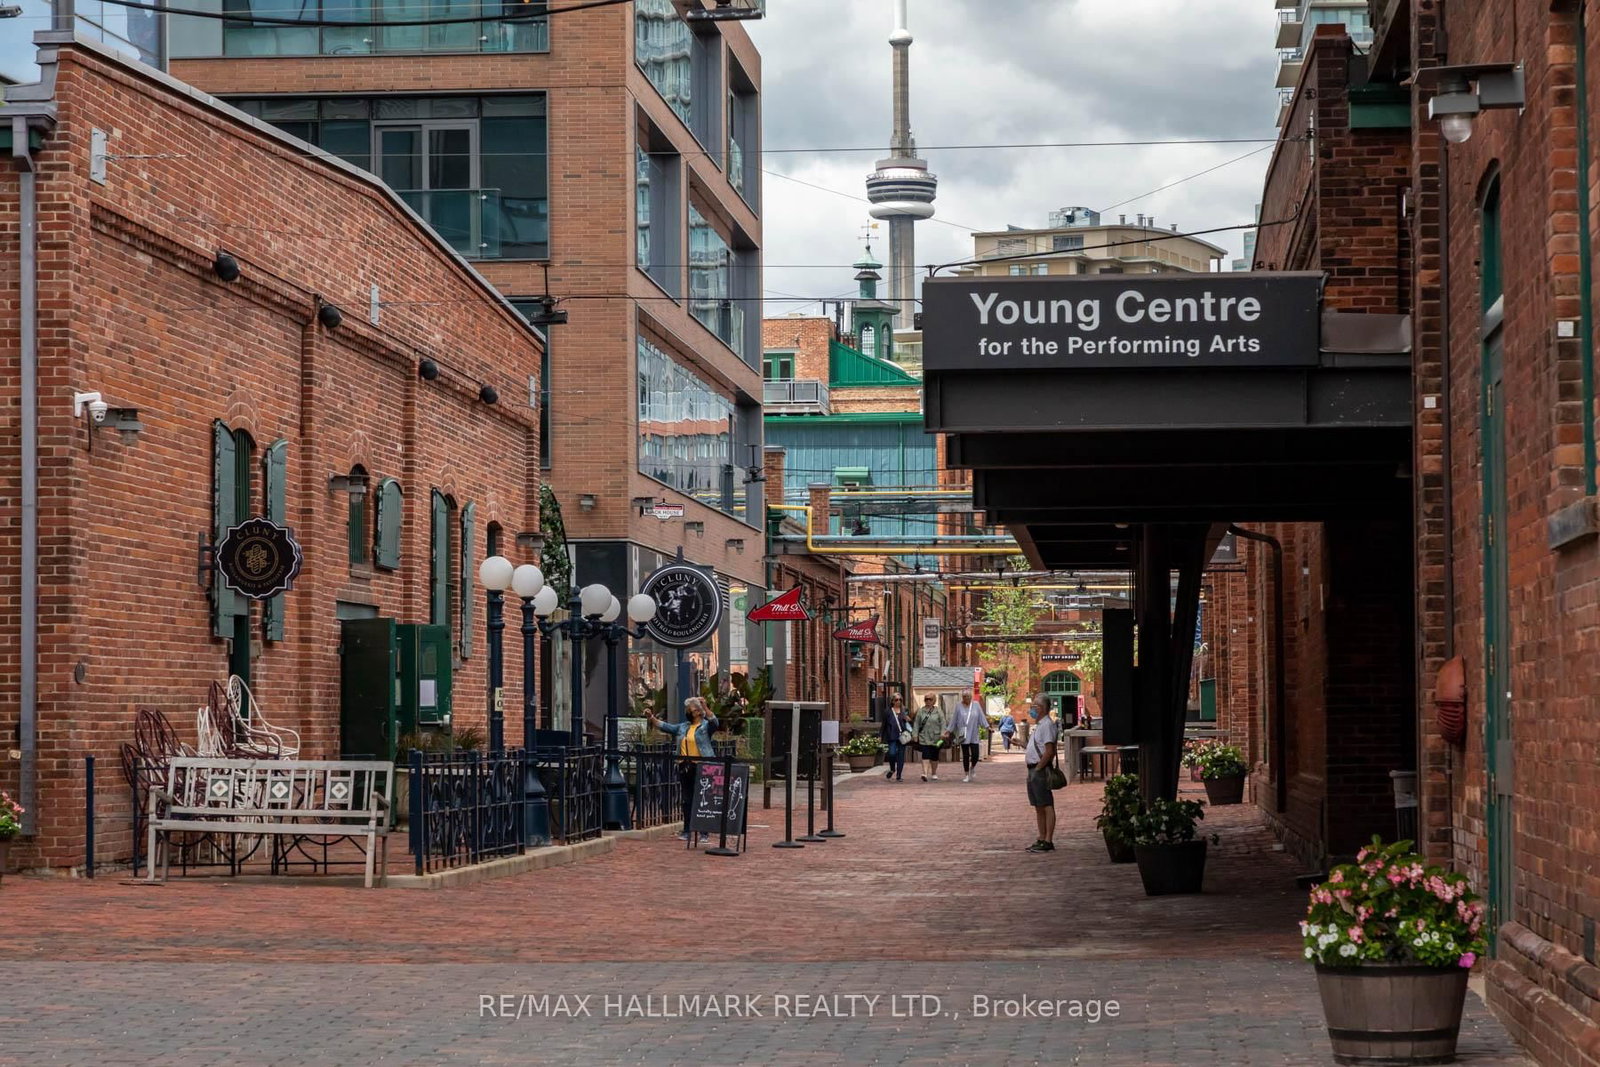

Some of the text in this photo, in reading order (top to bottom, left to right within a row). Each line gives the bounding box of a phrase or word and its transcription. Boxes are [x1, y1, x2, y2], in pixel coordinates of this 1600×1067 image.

[969, 289, 1261, 331] Young Centre
[978, 334, 1261, 357] for the Performing Arts
[236, 526, 279, 540] CLUNY
[660, 573, 698, 587] CLUNY
[770, 603, 789, 612] Mill
[673, 612, 709, 637] BOULANGERIE
[848, 628, 863, 636] Mill
